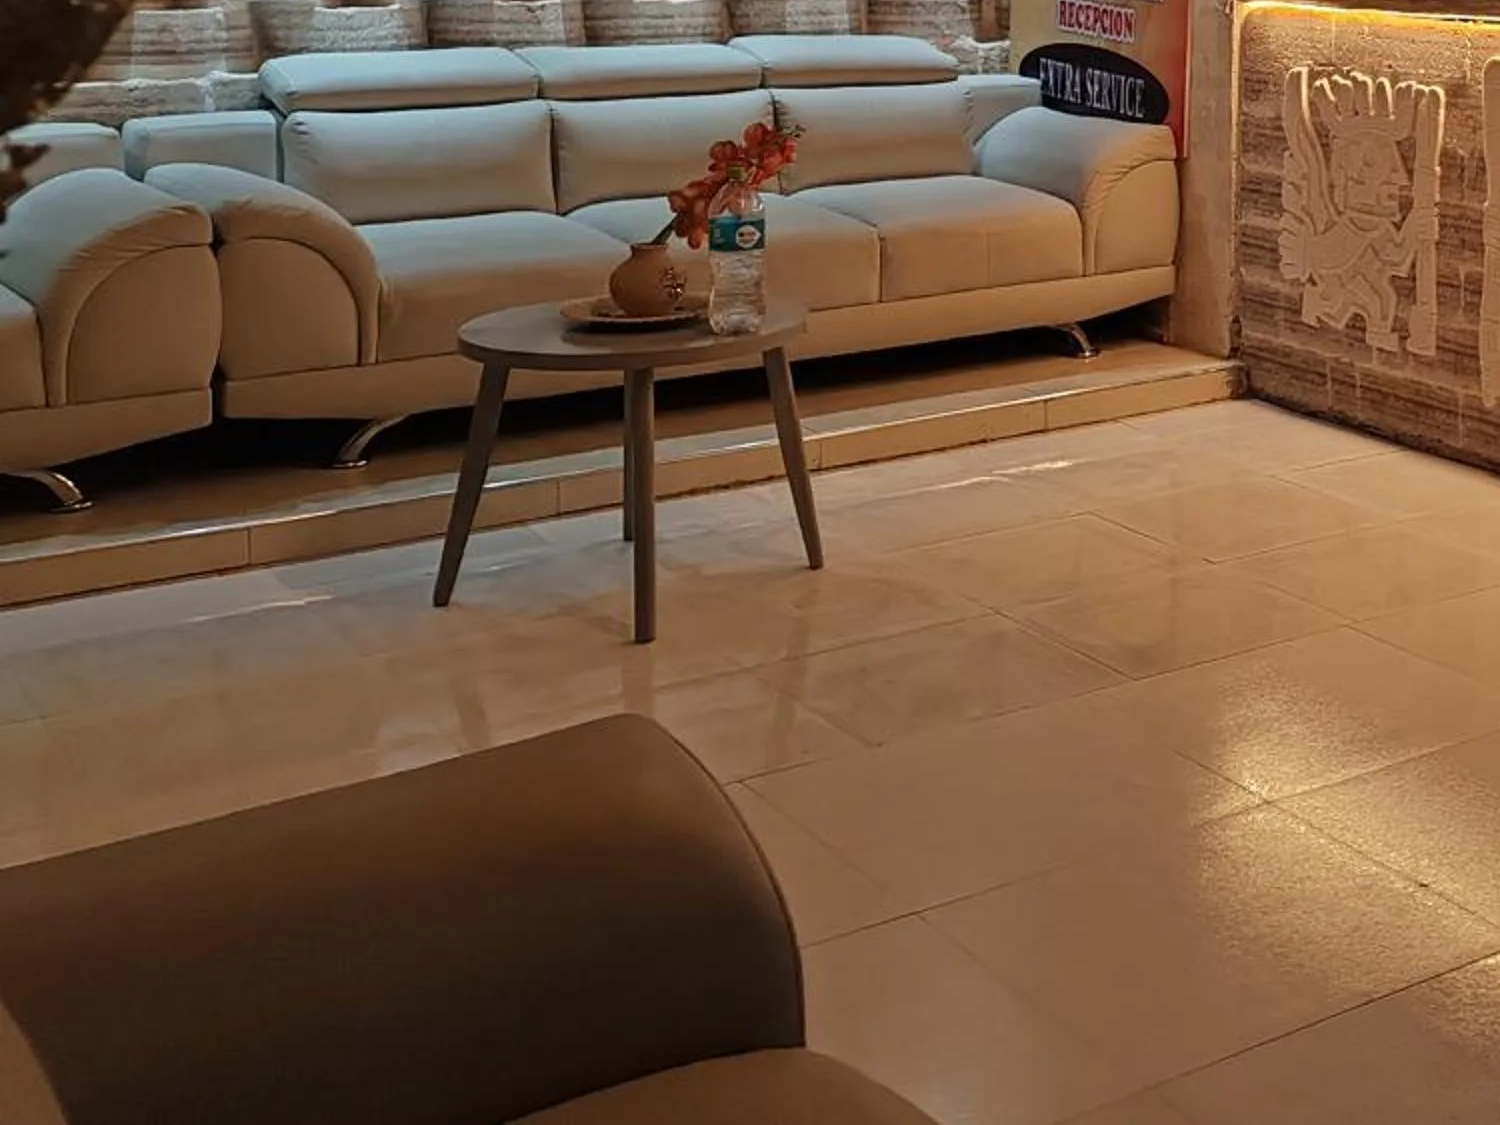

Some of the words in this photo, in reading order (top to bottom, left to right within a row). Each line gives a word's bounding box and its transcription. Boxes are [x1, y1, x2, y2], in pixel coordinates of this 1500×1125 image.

[1058, 1, 1134, 39] RECEPCION
[1040, 58, 1081, 104] EXTRA
[1086, 68, 1145, 118] SERVICE
